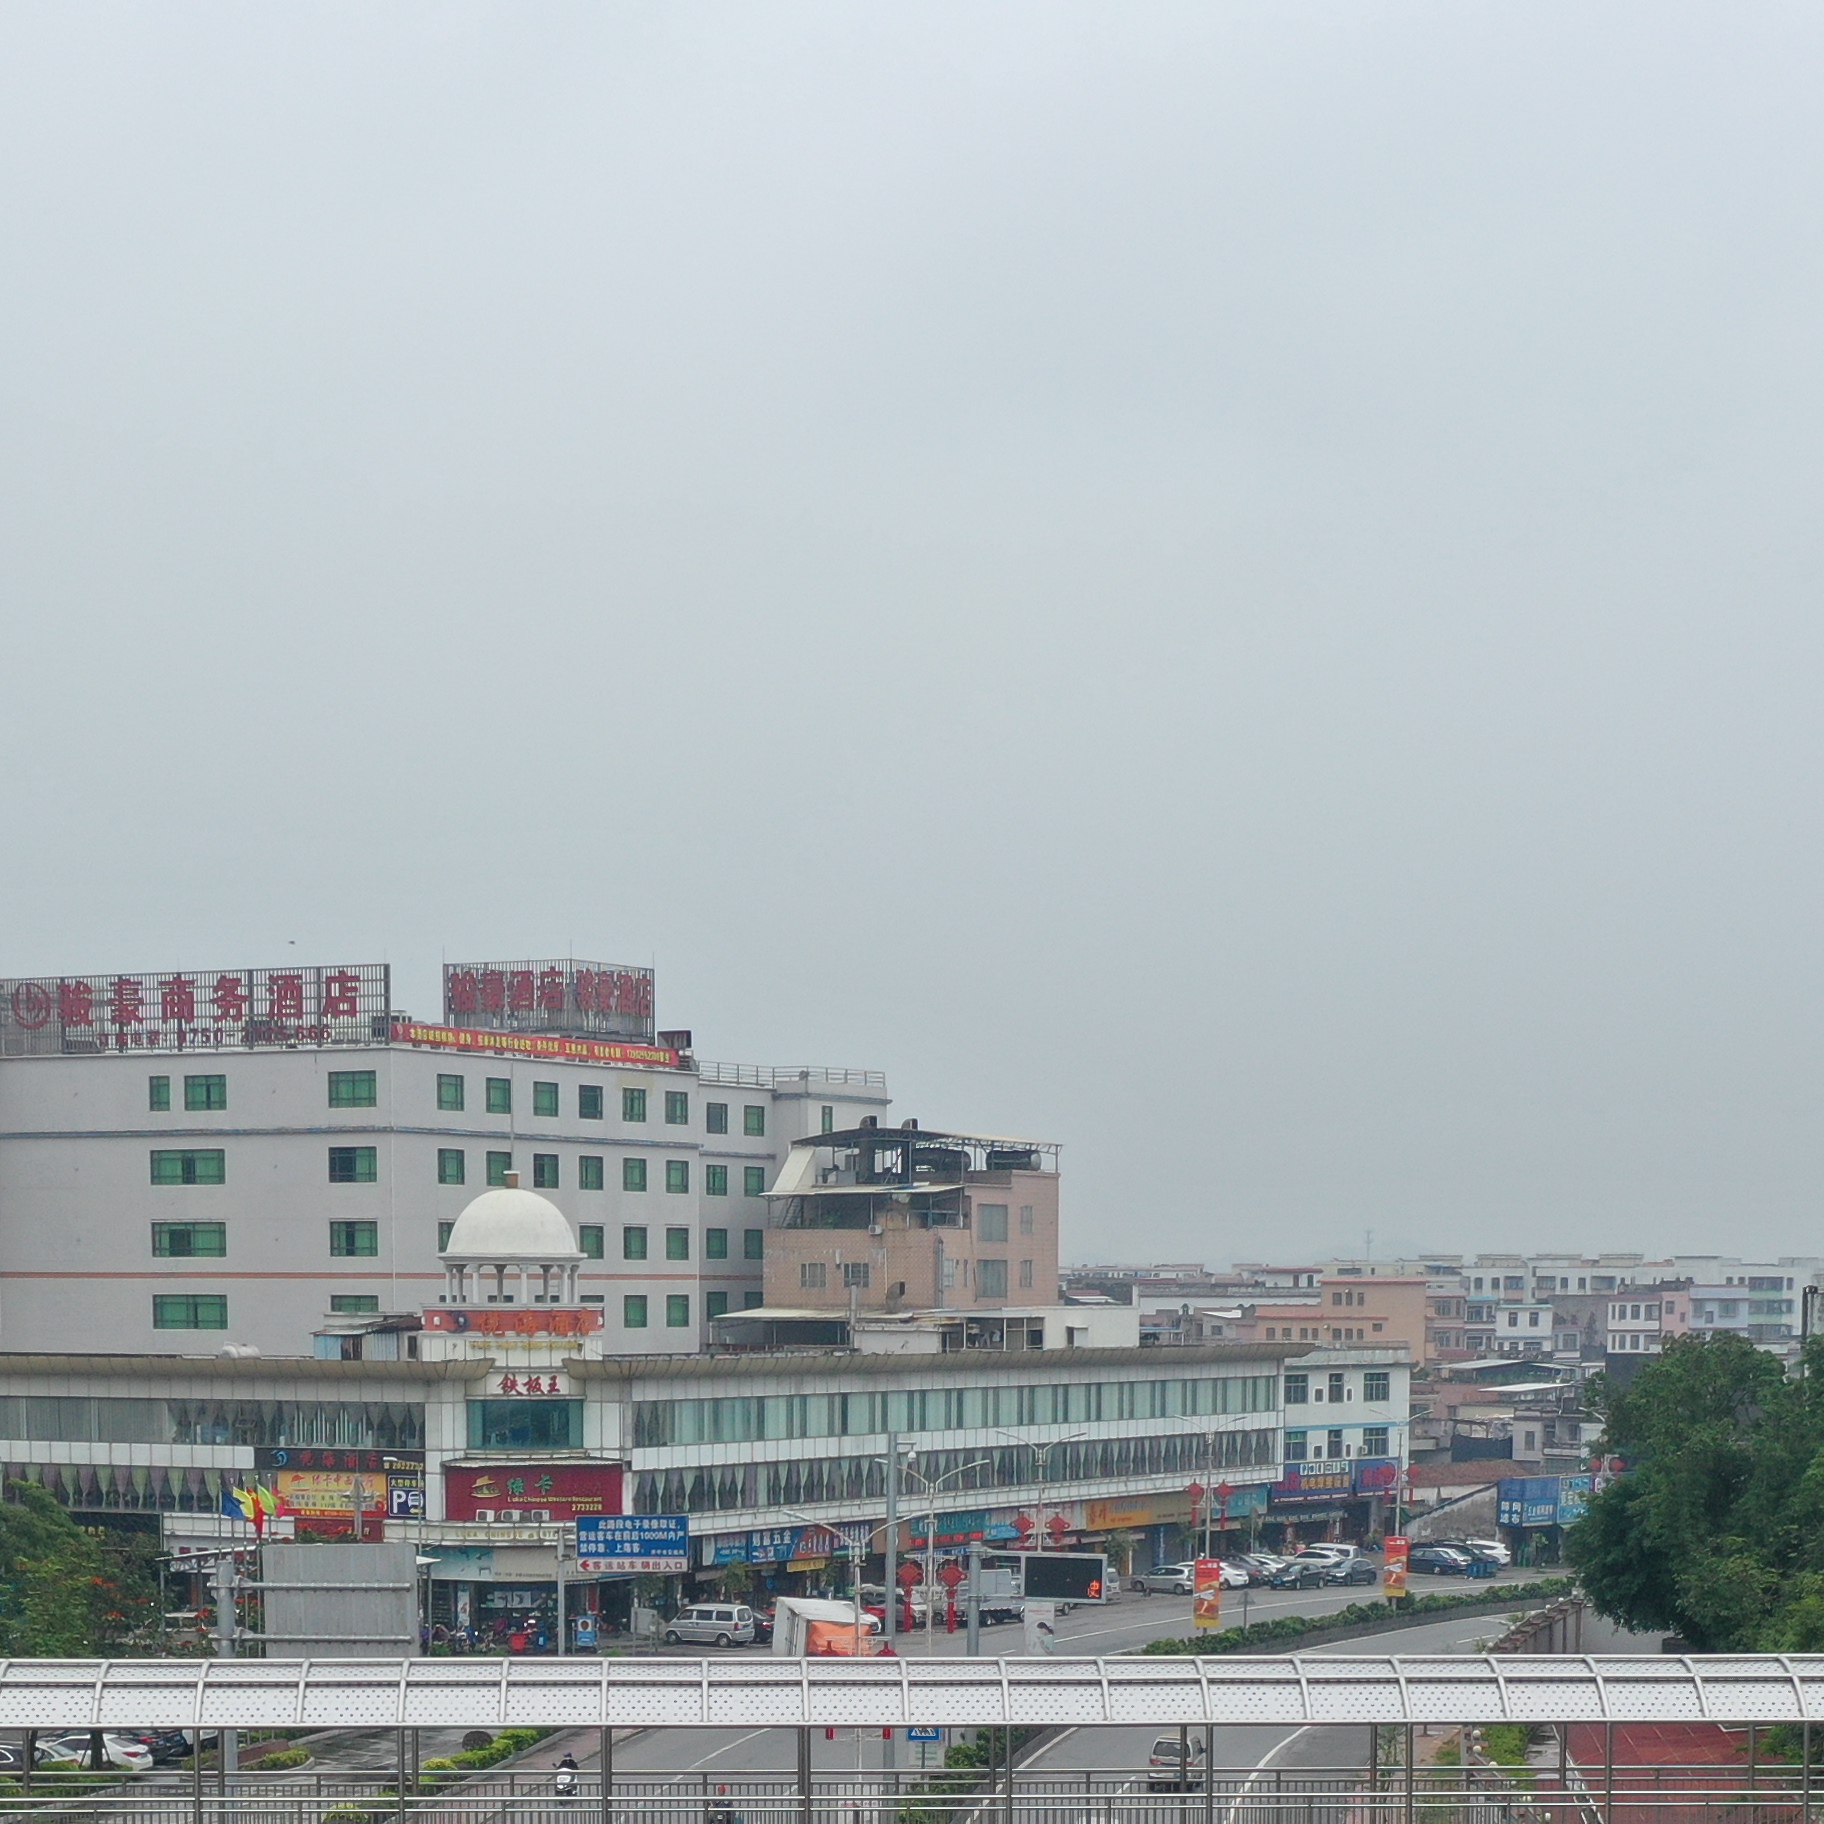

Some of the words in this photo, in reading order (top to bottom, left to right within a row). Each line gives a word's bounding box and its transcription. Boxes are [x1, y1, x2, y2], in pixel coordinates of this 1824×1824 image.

[312, 1474, 375, 1488] 绿卡中西厅
[392, 1490, 406, 1514] P
